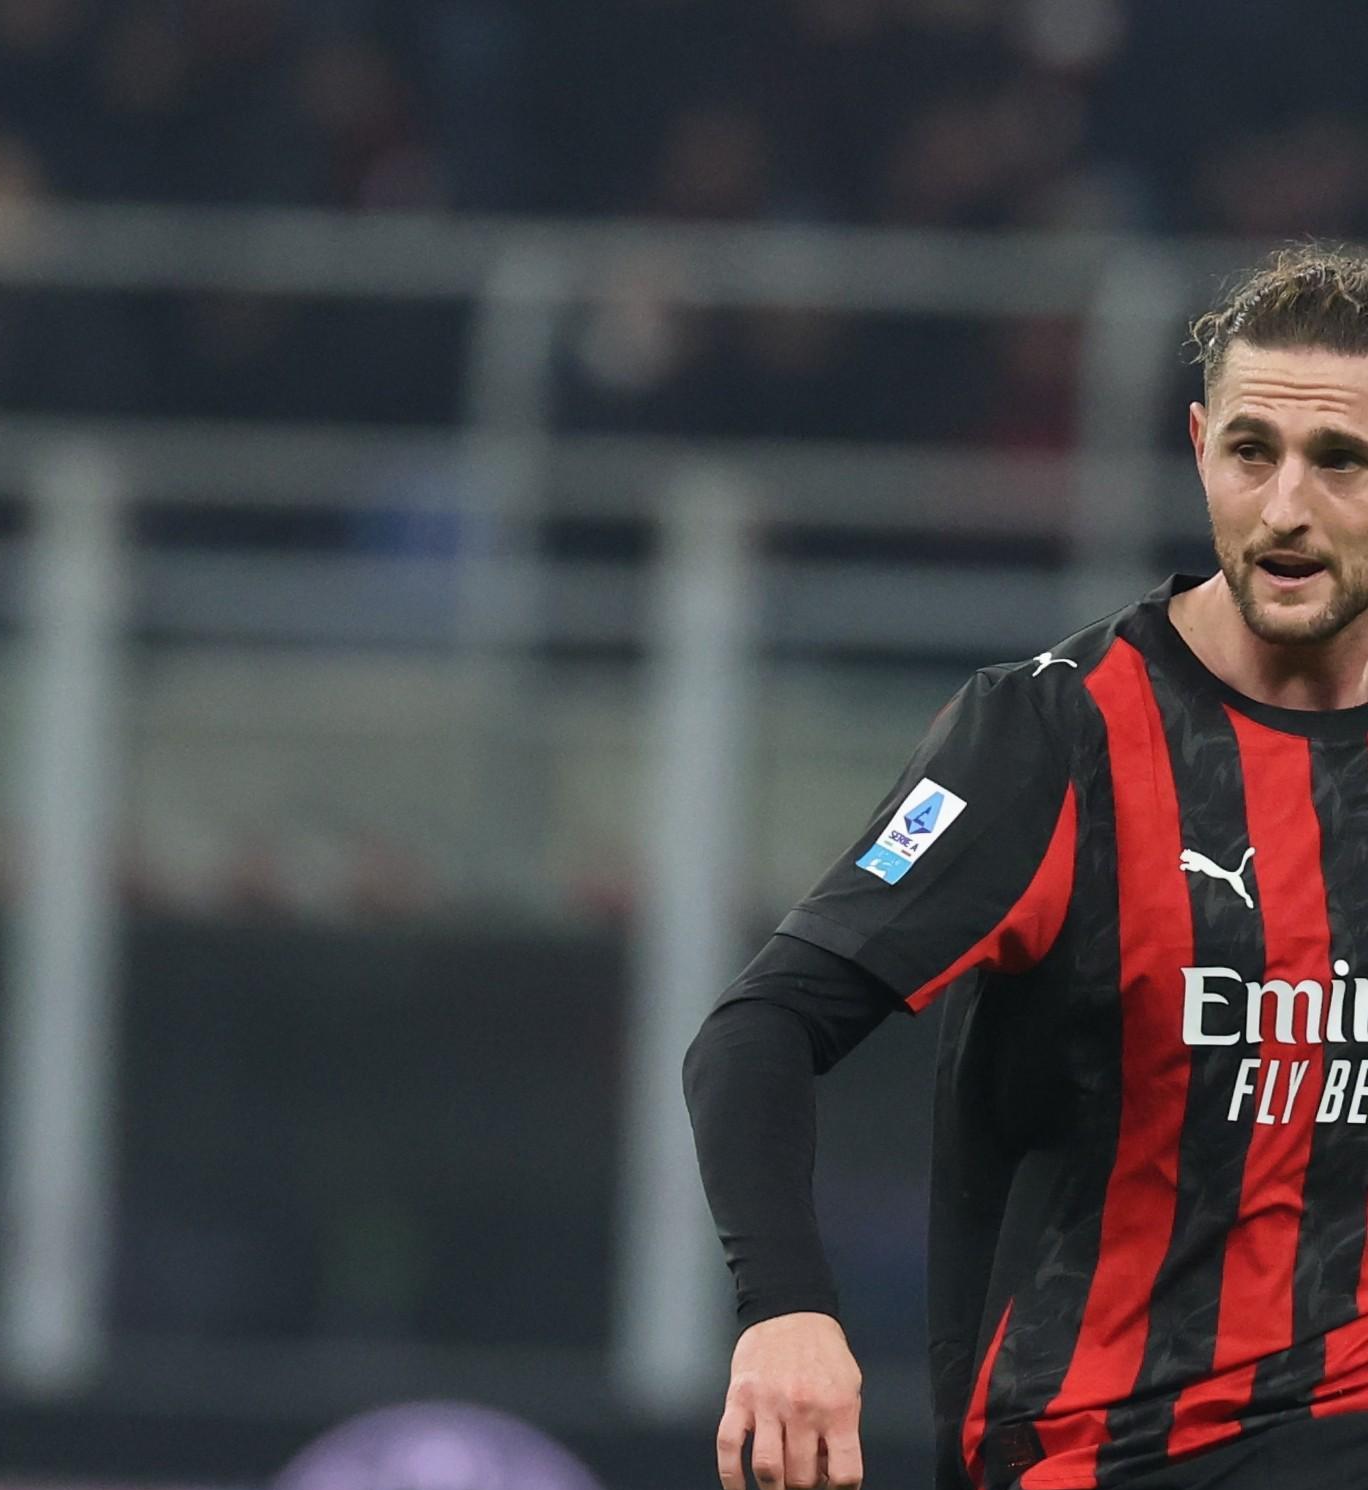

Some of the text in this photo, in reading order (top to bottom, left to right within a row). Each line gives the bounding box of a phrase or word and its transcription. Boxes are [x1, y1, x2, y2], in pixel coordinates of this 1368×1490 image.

[888, 830, 919, 852] SERIE A
[1227, 1058, 1310, 1125] FLY
